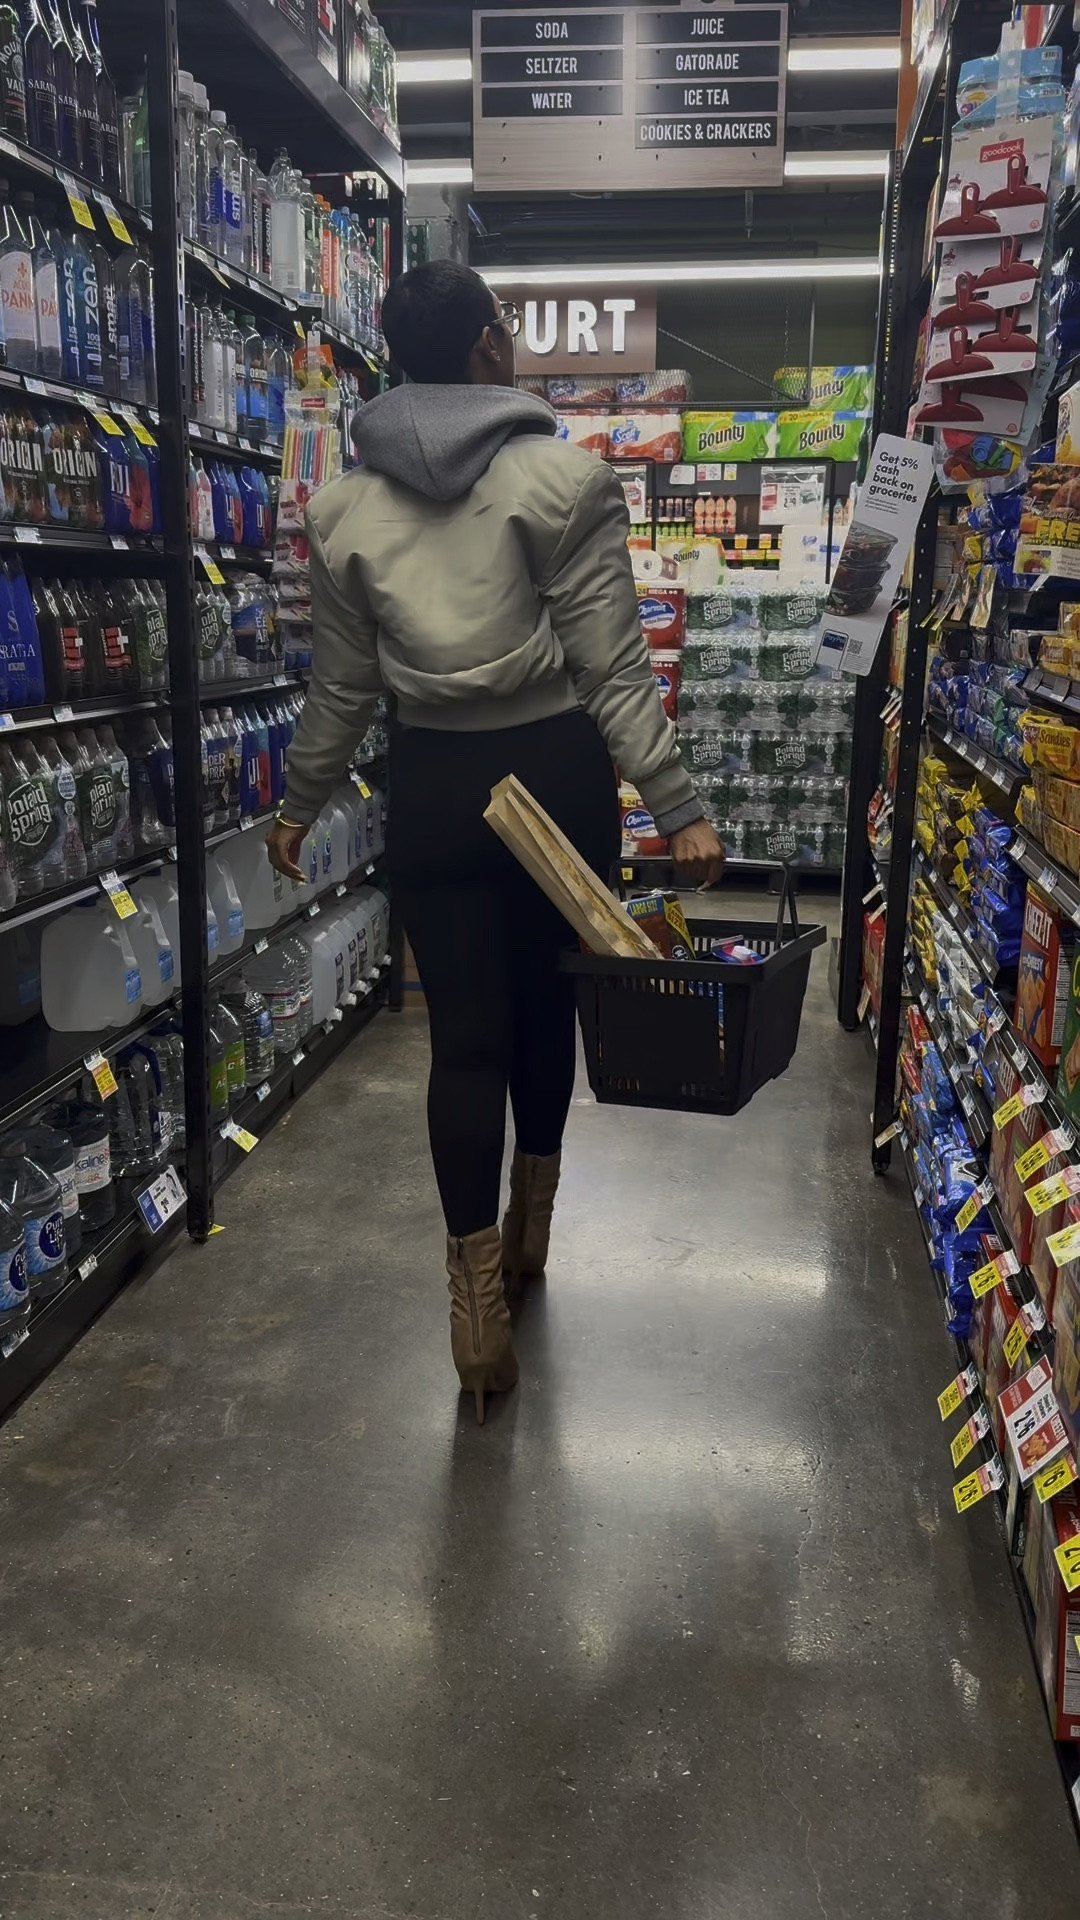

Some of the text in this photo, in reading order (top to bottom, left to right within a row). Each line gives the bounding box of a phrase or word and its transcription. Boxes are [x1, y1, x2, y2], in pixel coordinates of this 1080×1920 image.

[535, 22, 568, 39] SODA
[690, 18, 725, 36] JUICE
[525, 57, 578, 75] SELTZER
[675, 53, 740, 71] GATORADE
[531, 92, 572, 109] WATER
[683, 89, 729, 106] ICE TEA
[639, 122, 771, 142] COOKIES & CRACKERS
[982, 142, 1023, 162] goodcook
[0, 289, 34, 310] PANN
[514, 299, 636, 354] URT
[698, 424, 746, 452] Bounty
[799, 422, 846, 452] Bounty
[0, 436, 44, 473] ORIGIN
[879, 451, 919, 471] Get 5%
[51, 449, 98, 478] ORIGIN
[875, 463, 899, 477] cash
[872, 472, 914, 492] back on
[868, 485, 918, 504] groceries
[673, 549, 700, 564] Bounty
[703, 598, 732, 613] Poland
[703, 605, 733, 621] Spring
[786, 598, 816, 612] Poland
[787, 605, 817, 621] Spring
[700, 648, 730, 662] Poland
[782, 648, 812, 662] Poland
[700, 656, 731, 673] Spring
[783, 657, 814, 673] Spring
[1039, 728, 1071, 746] Sandies
[691, 741, 722, 756] Poland
[692, 749, 723, 765] Spring
[774, 744, 805, 758] Poland
[775, 752, 806, 767] Spring
[766, 834, 796, 849] Poland
[767, 842, 797, 857] Spring
[644, 901, 658, 914] SIZE
